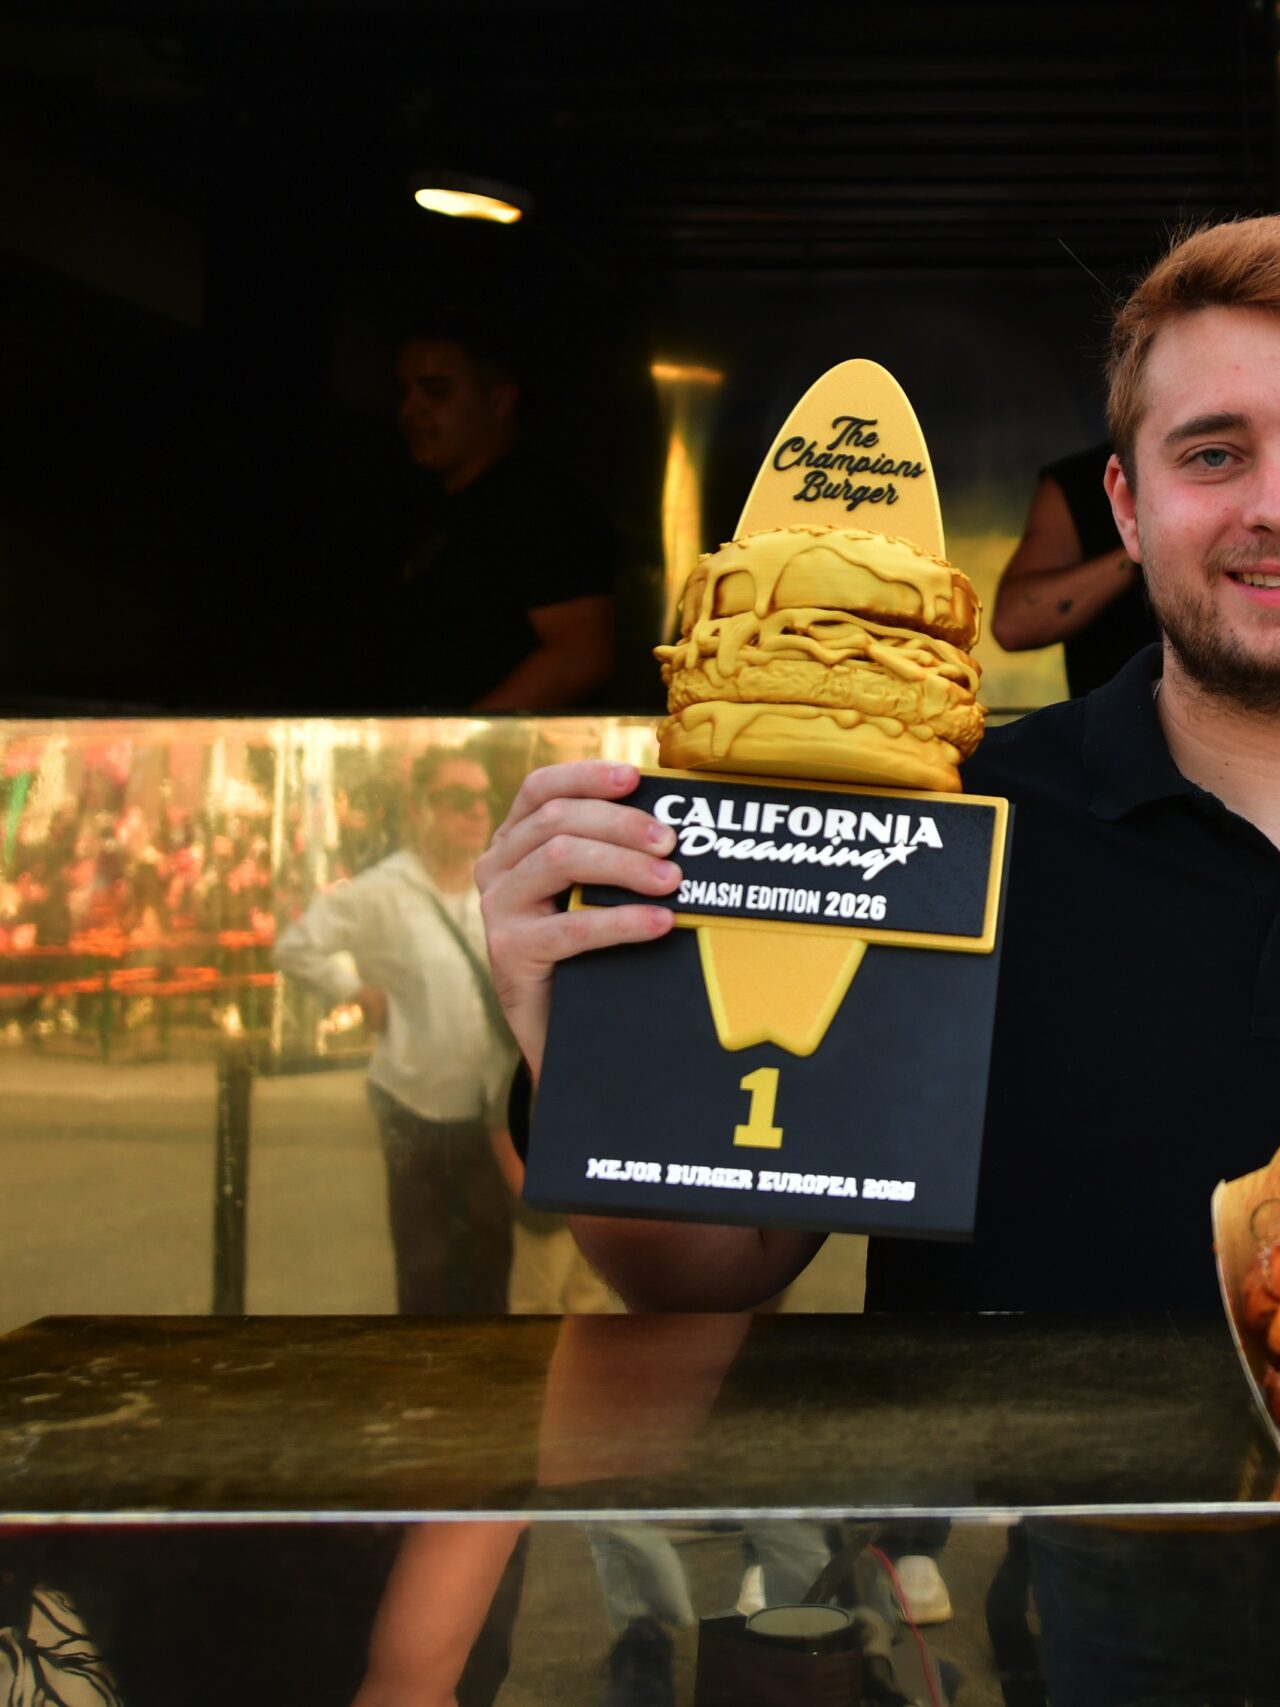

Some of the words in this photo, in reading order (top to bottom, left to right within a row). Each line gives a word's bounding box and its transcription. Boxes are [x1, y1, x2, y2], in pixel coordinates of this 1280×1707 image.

[826, 415, 880, 452] The
[773, 436, 926, 478] Champions
[793, 470, 899, 512] Burger
[653, 794, 944, 849] CALIFORNIA
[678, 825, 890, 882] Dreaming
[677, 879, 744, 908] SMASH
[745, 884, 821, 915] EDITION
[823, 891, 888, 921] 2026
[733, 1067, 783, 1149] 1
[586, 1158, 662, 1183] MEJOR
[665, 1163, 753, 1190] BURGER
[757, 1171, 858, 1198] EUROPEA
